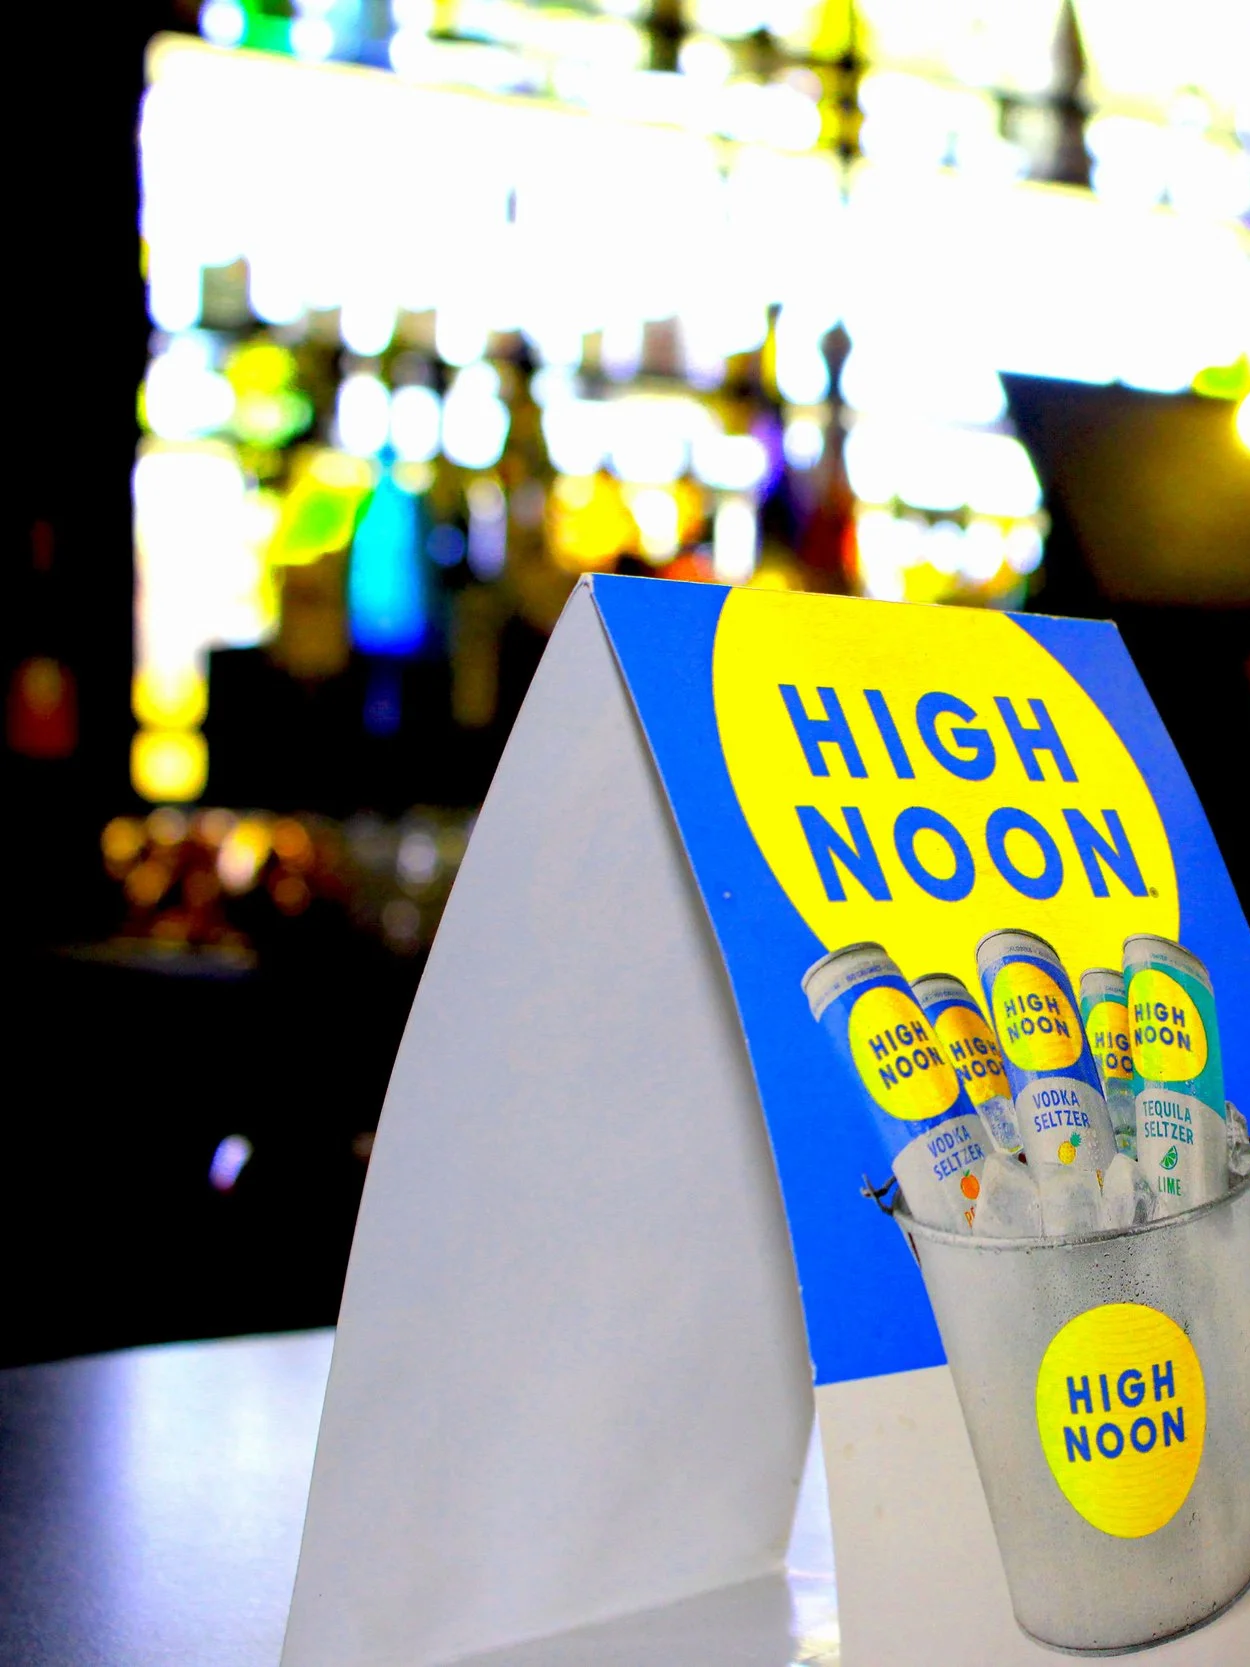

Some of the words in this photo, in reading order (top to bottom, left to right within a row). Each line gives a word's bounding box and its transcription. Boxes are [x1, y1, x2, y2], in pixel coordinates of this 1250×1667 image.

[778, 684, 1079, 782] HIGH
[795, 806, 1149, 902] NOON
[1004, 993, 1061, 1018] HIGH
[1134, 1002, 1185, 1028] HIGH
[868, 1020, 929, 1061] HIGH
[1007, 1016, 1070, 1043] NOON
[1095, 1032, 1129, 1052] HIG
[1134, 1026, 1191, 1051] NOON
[878, 1046, 945, 1090] NOON
[955, 1058, 1005, 1082] NOO
[1032, 1089, 1080, 1110] VODKA
[1143, 1100, 1192, 1124] TEQUILA
[1034, 1110, 1091, 1132] SELTZER
[1144, 1121, 1194, 1145] SELTZER
[927, 1125, 971, 1158] VODKA
[933, 1143, 986, 1181] SELTZER
[1158, 1176, 1182, 1196] LIME
[1066, 1360, 1175, 1415] HIGH
[1063, 1407, 1185, 1463] NOON
